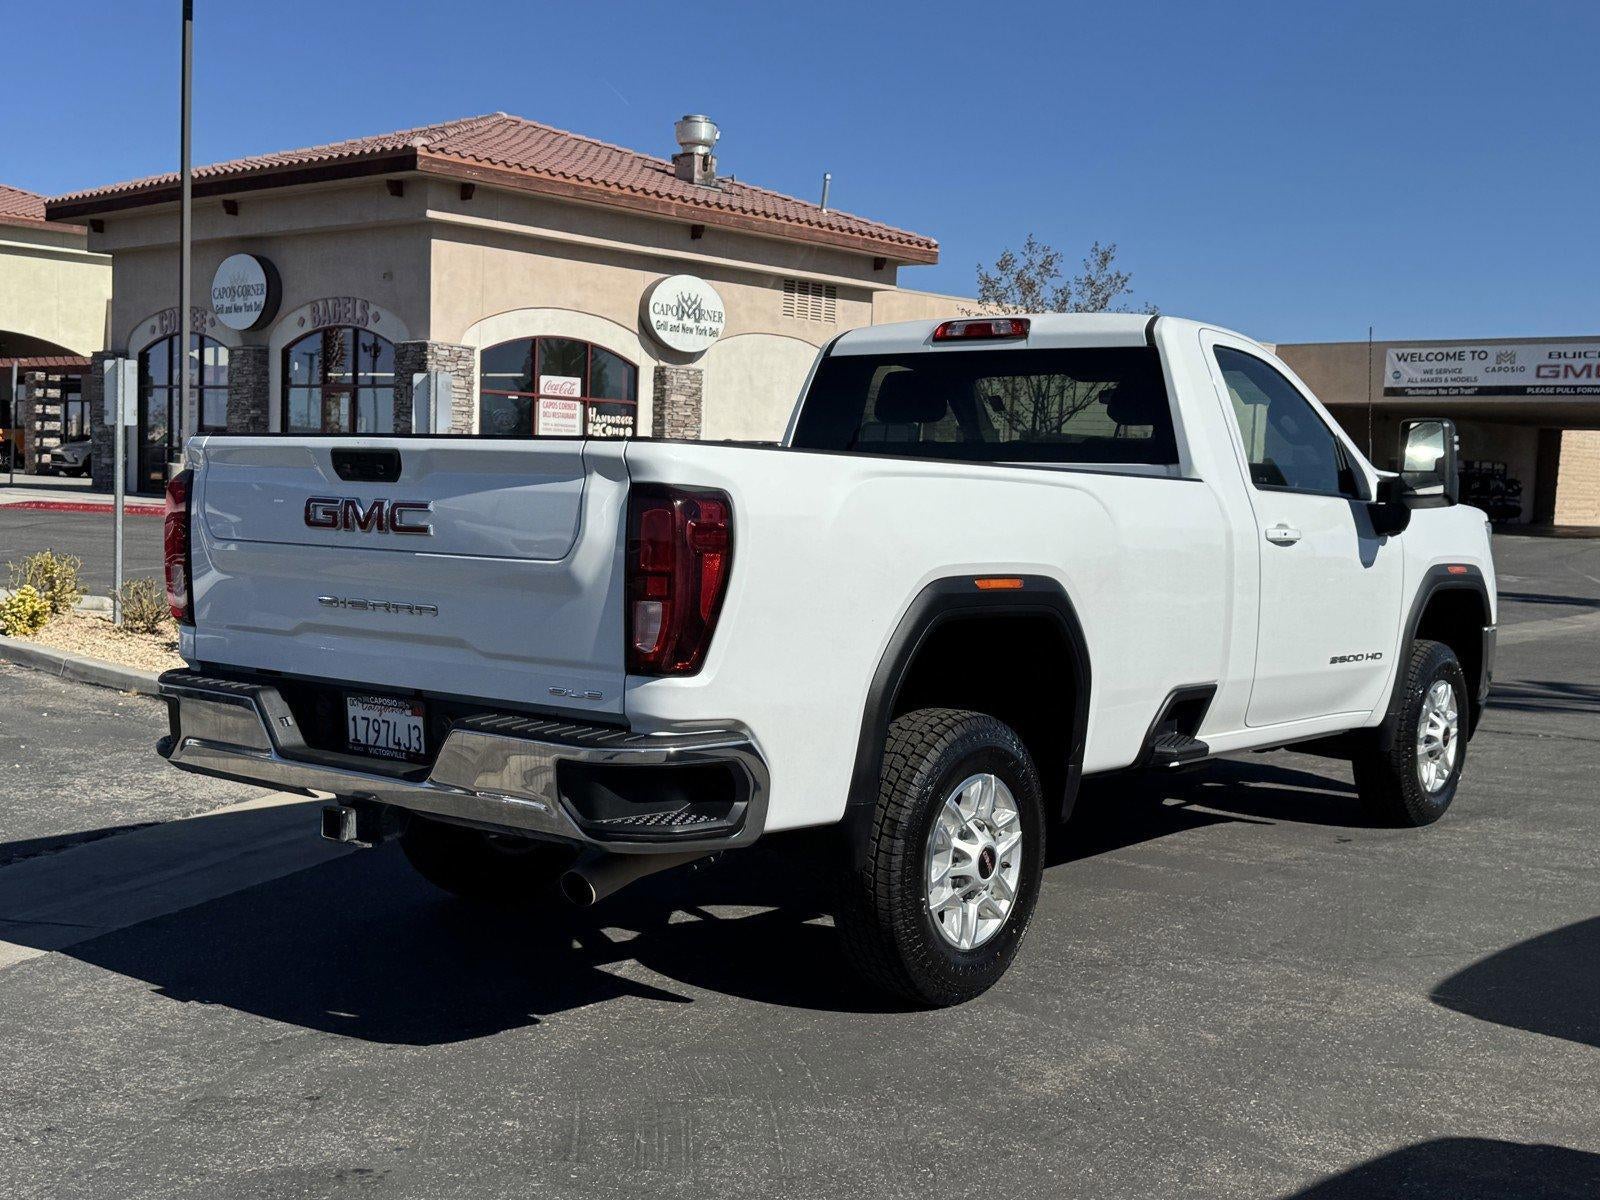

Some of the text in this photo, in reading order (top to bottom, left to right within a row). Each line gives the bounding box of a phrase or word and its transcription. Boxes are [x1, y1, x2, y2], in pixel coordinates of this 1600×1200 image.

[310, 299, 370, 328] BAGELS
[655, 319, 720, 338] Grill and New York Deli
[1395, 350, 1488, 363] WELCOME TO
[1548, 350, 1600, 360] BUIC
[1422, 367, 1463, 376] WE SERVICE
[1484, 365, 1526, 374] CAPOSIO
[1535, 363, 1600, 379] GM
[1450, 375, 1478, 383] MODELS
[1526, 387, 1555, 395] PLEASE
[303, 495, 435, 536] GMC
[317, 595, 439, 618] SIERRA
[1329, 652, 1383, 665] 2500 HD
[369, 696, 399, 707] CAPOSIO
[351, 714, 423, 753] 17974J3
[368, 747, 407, 760] VICTORVILLE
